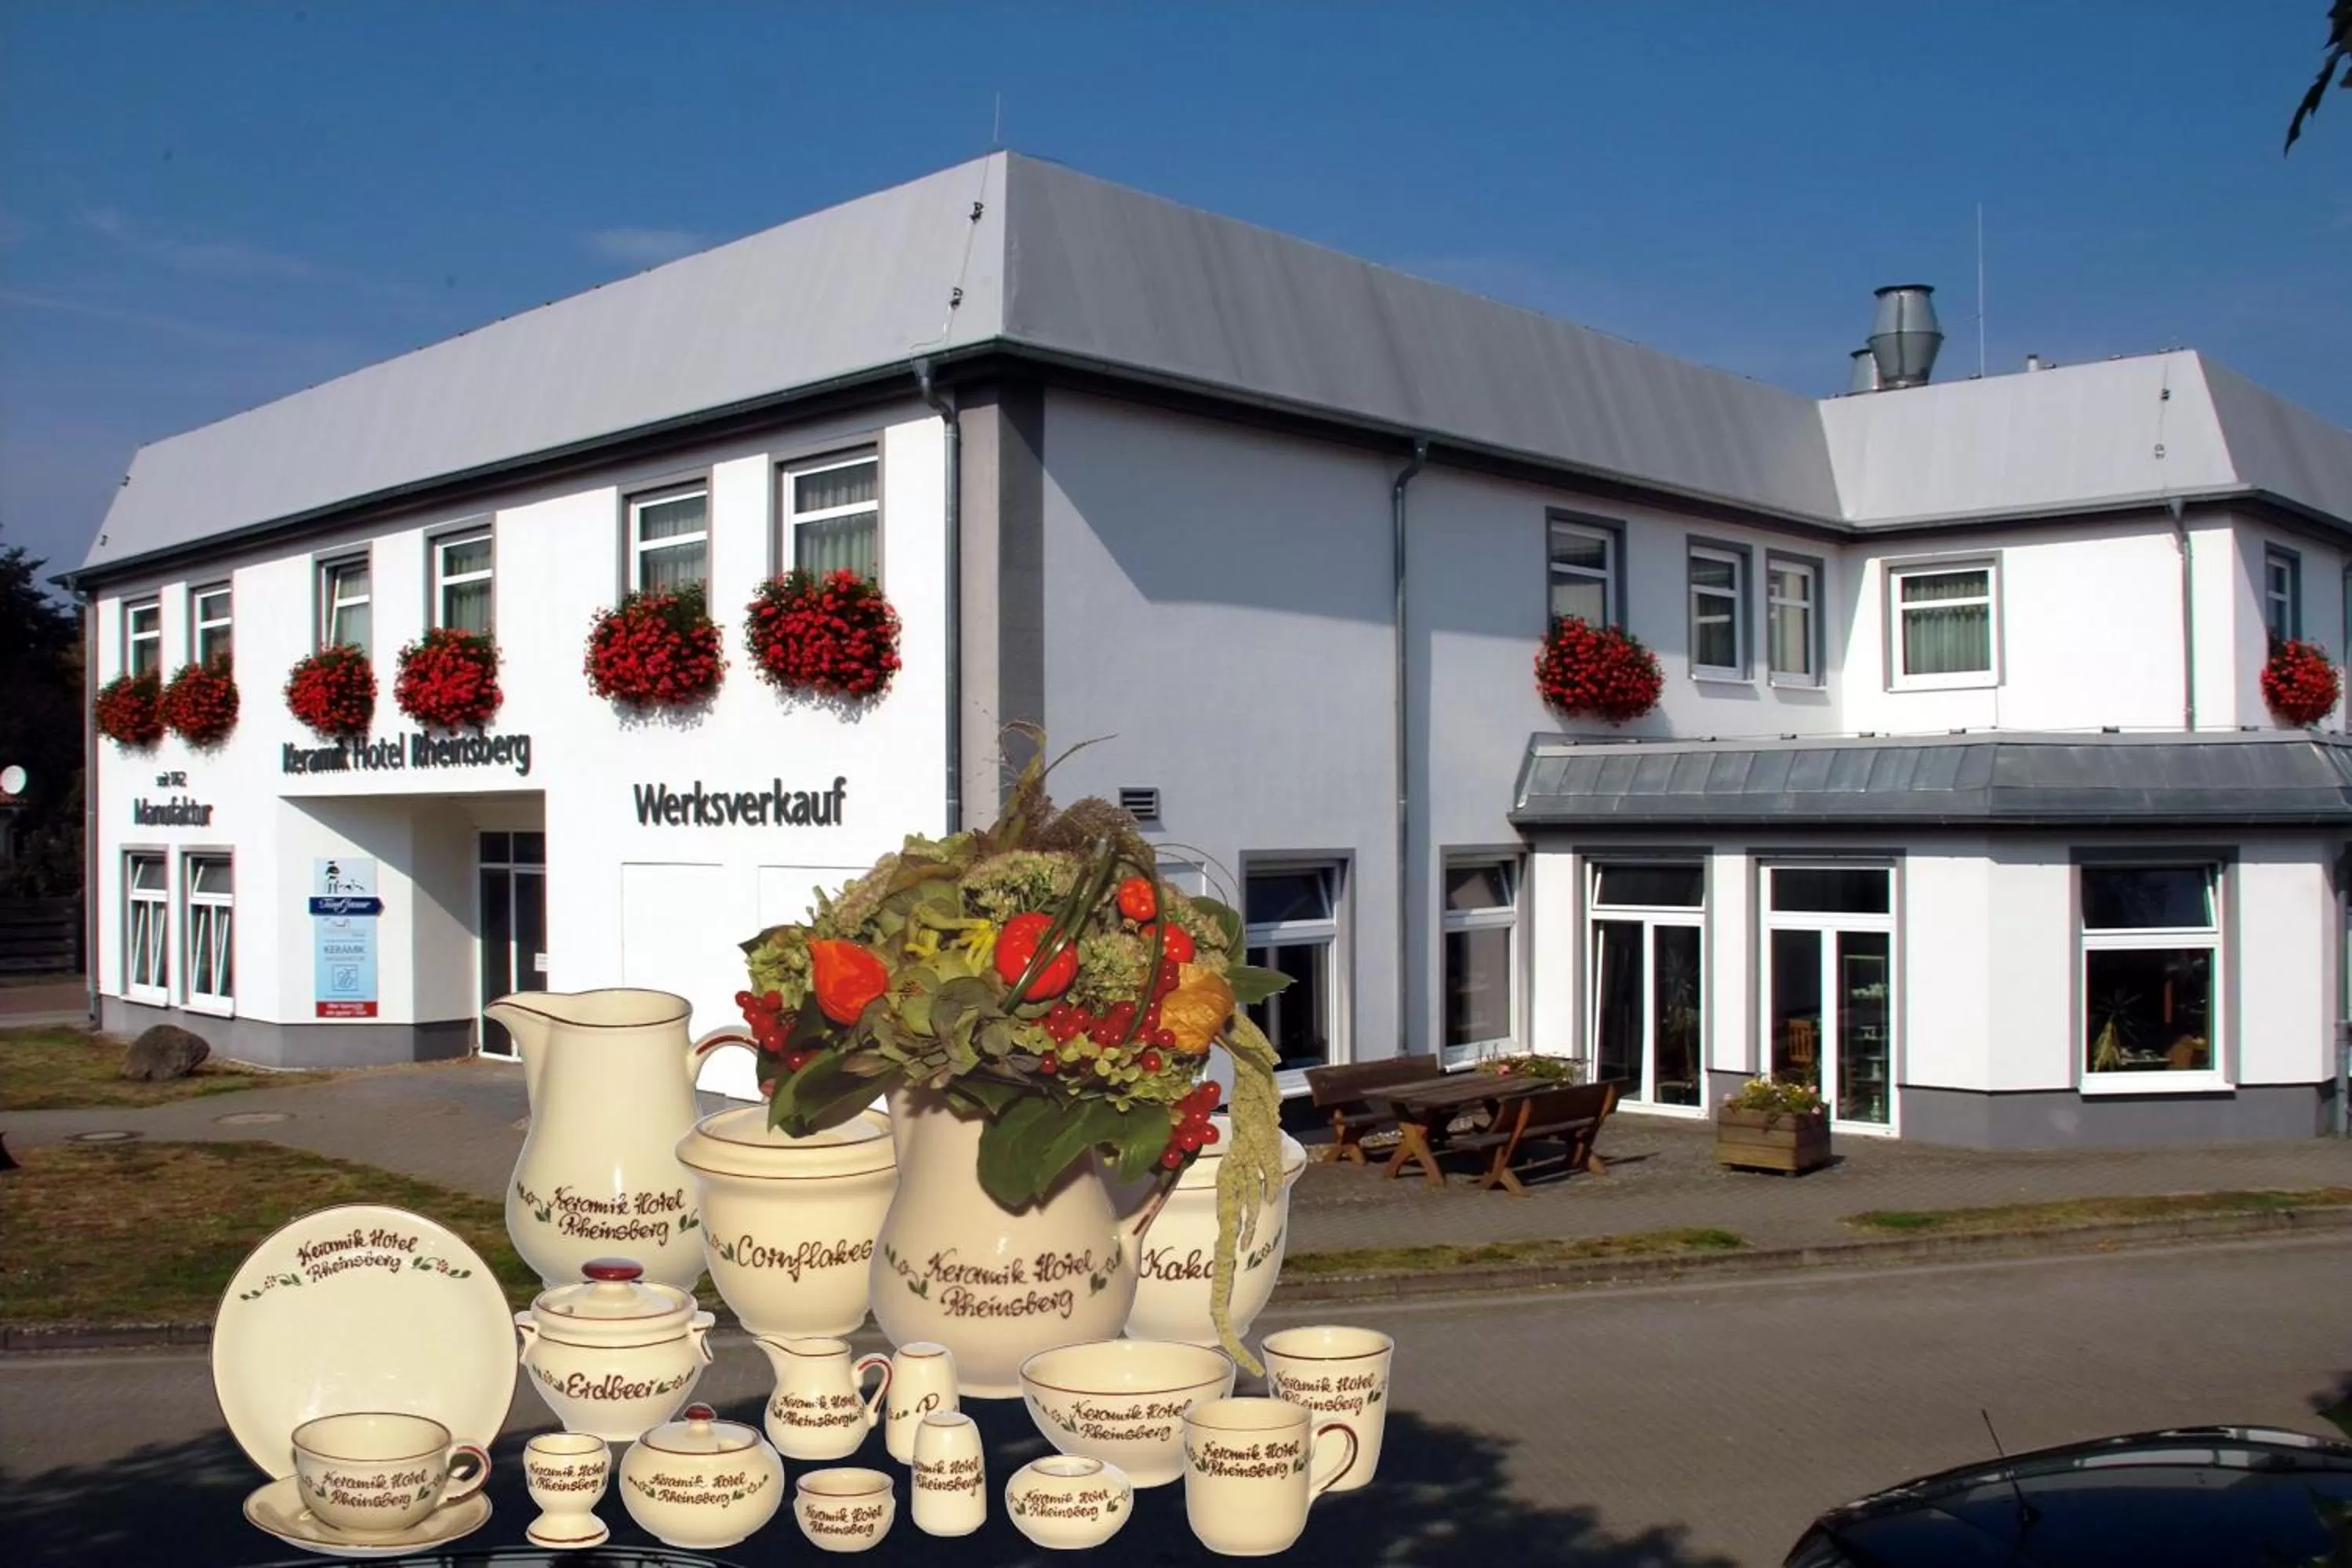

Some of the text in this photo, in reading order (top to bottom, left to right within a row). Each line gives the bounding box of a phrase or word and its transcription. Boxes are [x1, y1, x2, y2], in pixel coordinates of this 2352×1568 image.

[353, 732, 405, 771] Hotel
[412, 731, 531, 776] Rheinsberg
[633, 776, 847, 826] Werksverkauf
[547, 1185, 686, 1215] Keramik Hotel
[558, 1212, 669, 1247] Rheinsberg
[297, 1229, 418, 1267] Keramik Hotel
[737, 1235, 873, 1283] Cornflakes
[306, 1251, 401, 1283] Rheinsberg
[924, 1248, 1096, 1285] Keramik Hotel
[940, 1285, 1073, 1319] Rheinsberg
[566, 1372, 657, 1400] Erdbeer
[1276, 1370, 1374, 1392] Keramik Hotel
[780, 1392, 857, 1410] Keramik Hotel
[1071, 1399, 1144, 1421] Keramik
[783, 1410, 849, 1428] Rheinsberg
[1080, 1423, 1171, 1442] Rheinsberg
[1204, 1439, 1299, 1461] Keramik Hotel
[949, 1456, 978, 1474] Hotel
[1208, 1460, 1288, 1479] Rheinsberg
[322, 1468, 427, 1490] Keramik Hotel
[649, 1471, 747, 1488] Keramik Hotel
[329, 1489, 412, 1510] Rheinsberg
[657, 1489, 730, 1508] Rheinsberg
[1022, 1488, 1110, 1504] Keramik Hotel
[805, 1504, 884, 1523] Keramik Hotel
[1029, 1502, 1098, 1522] Rheinsberg
[809, 1520, 875, 1537] Rheinsberg
